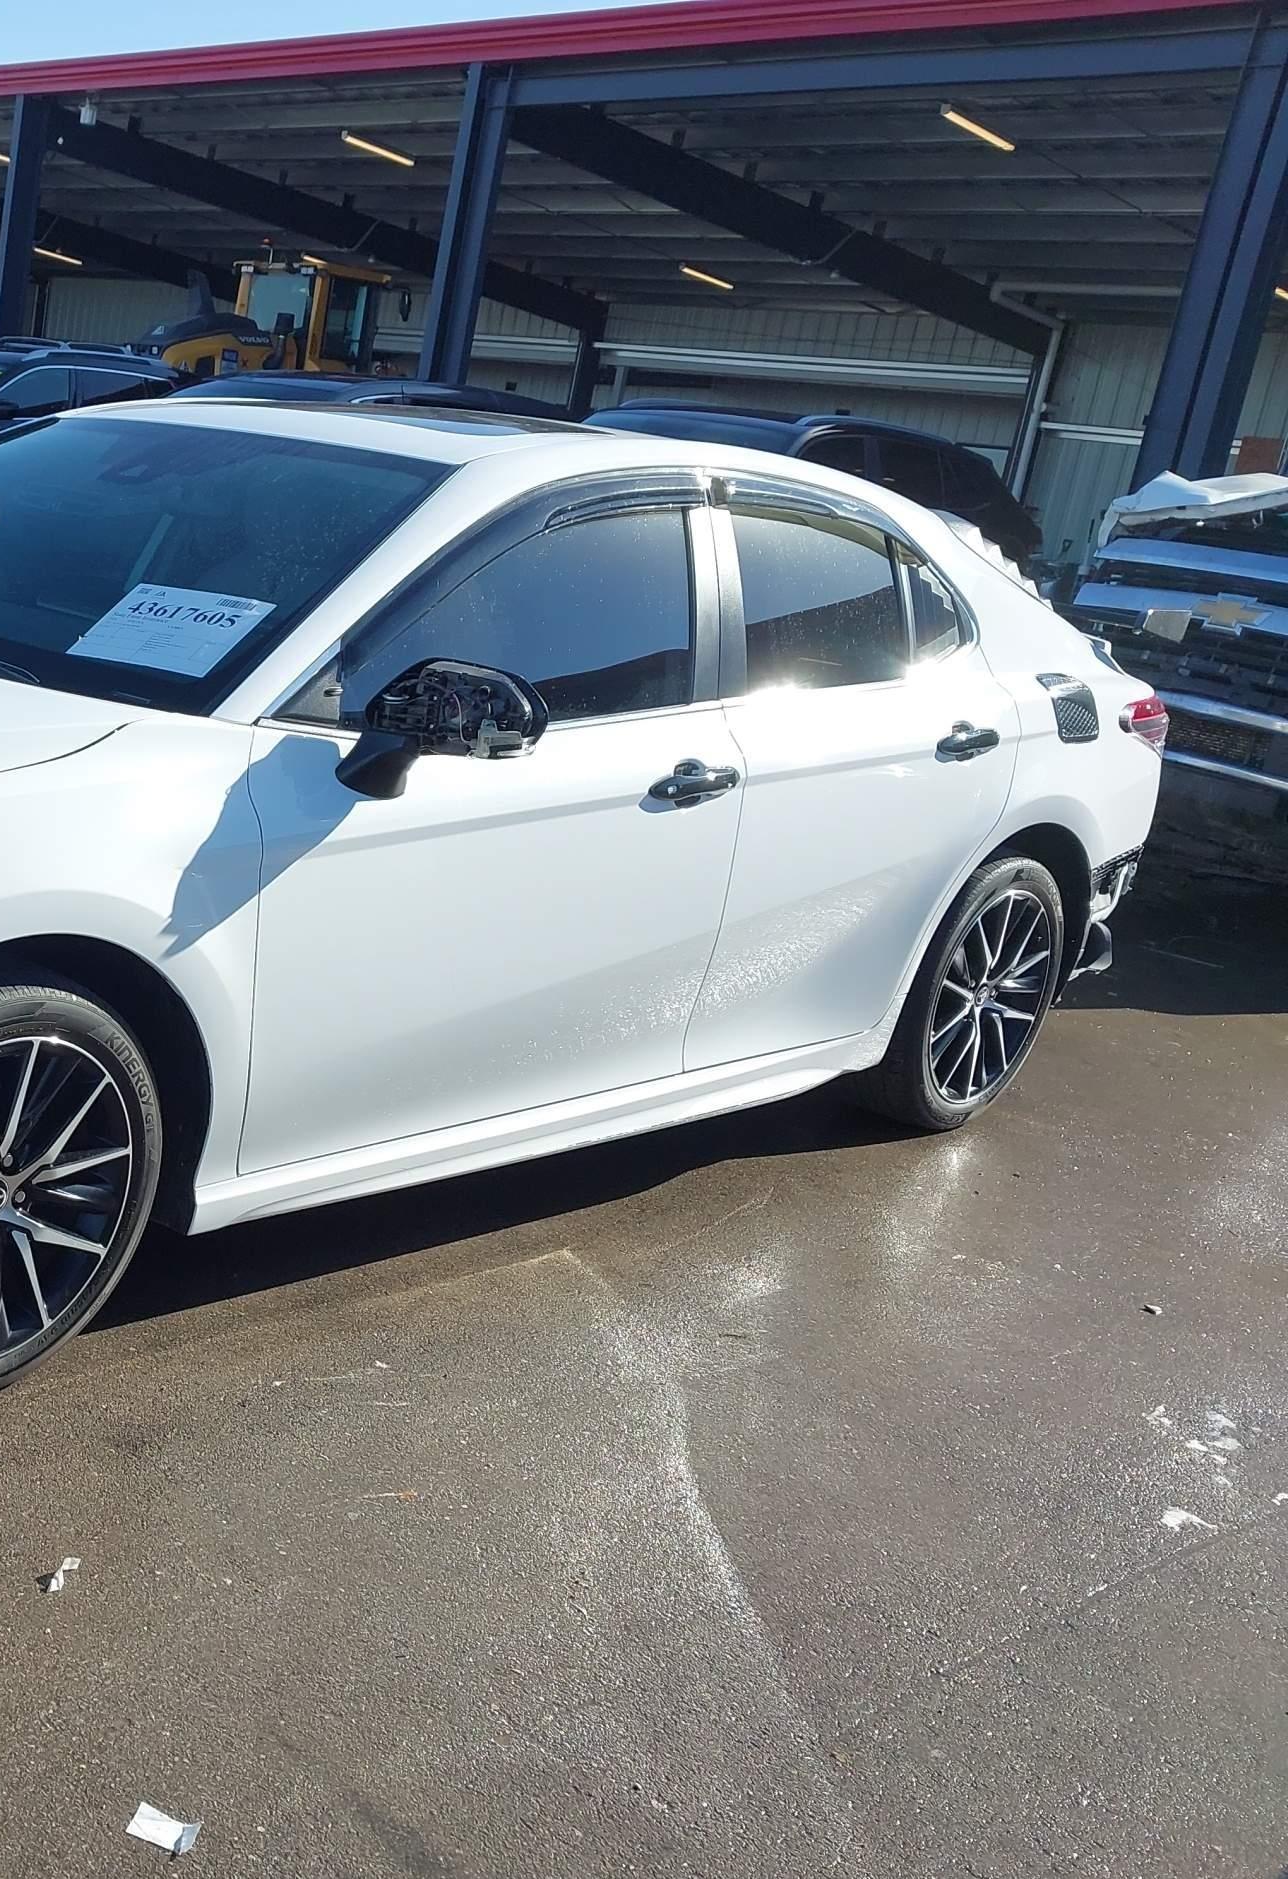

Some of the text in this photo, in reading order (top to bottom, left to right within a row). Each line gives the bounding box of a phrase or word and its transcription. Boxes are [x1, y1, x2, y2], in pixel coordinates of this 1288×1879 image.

[239, 335, 270, 344] VOLVO
[127, 600, 243, 629] 43617605
[105, 1031, 154, 1107] KINERGY
